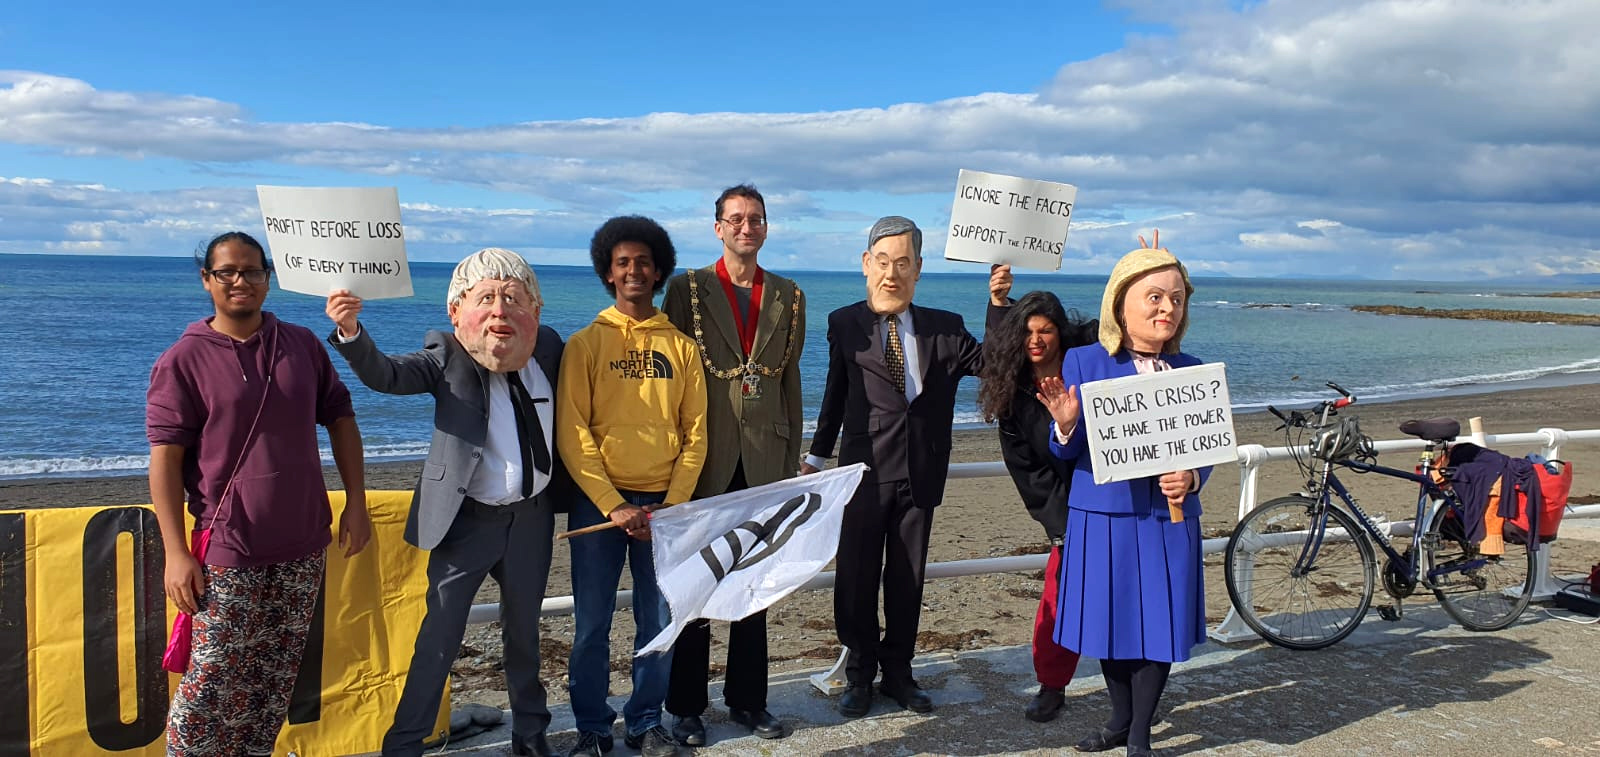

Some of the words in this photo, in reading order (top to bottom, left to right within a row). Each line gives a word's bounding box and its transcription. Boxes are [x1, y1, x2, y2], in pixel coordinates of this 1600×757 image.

[960, 185, 1003, 205] IGNORE
[1009, 192, 1031, 210] THE
[1036, 198, 1072, 217] FACTS
[266, 217, 304, 236] PROFIT
[311, 221, 360, 239] BEFORE
[368, 222, 401, 239] LOSS
[952, 224, 1007, 245] SUPPORT
[1022, 236, 1063, 255] FRACKS
[285, 253, 302, 269] (OF
[309, 259, 344, 273] EVERY
[610, 360, 652, 370] NORTH
[628, 350, 651, 360] THE
[624, 369, 654, 379] FACE
[1092, 392, 1148, 418] POWER
[1099, 426, 1117, 441] WE
[1122, 420, 1151, 438] HAVE
[1156, 416, 1179, 432] THE
[1184, 407, 1225, 428] POWER
[1101, 448, 1128, 466] YOU
[1132, 444, 1160, 462] HAVE
[1165, 438, 1188, 457] THE
[1192, 432, 1231, 452] CRISIS
